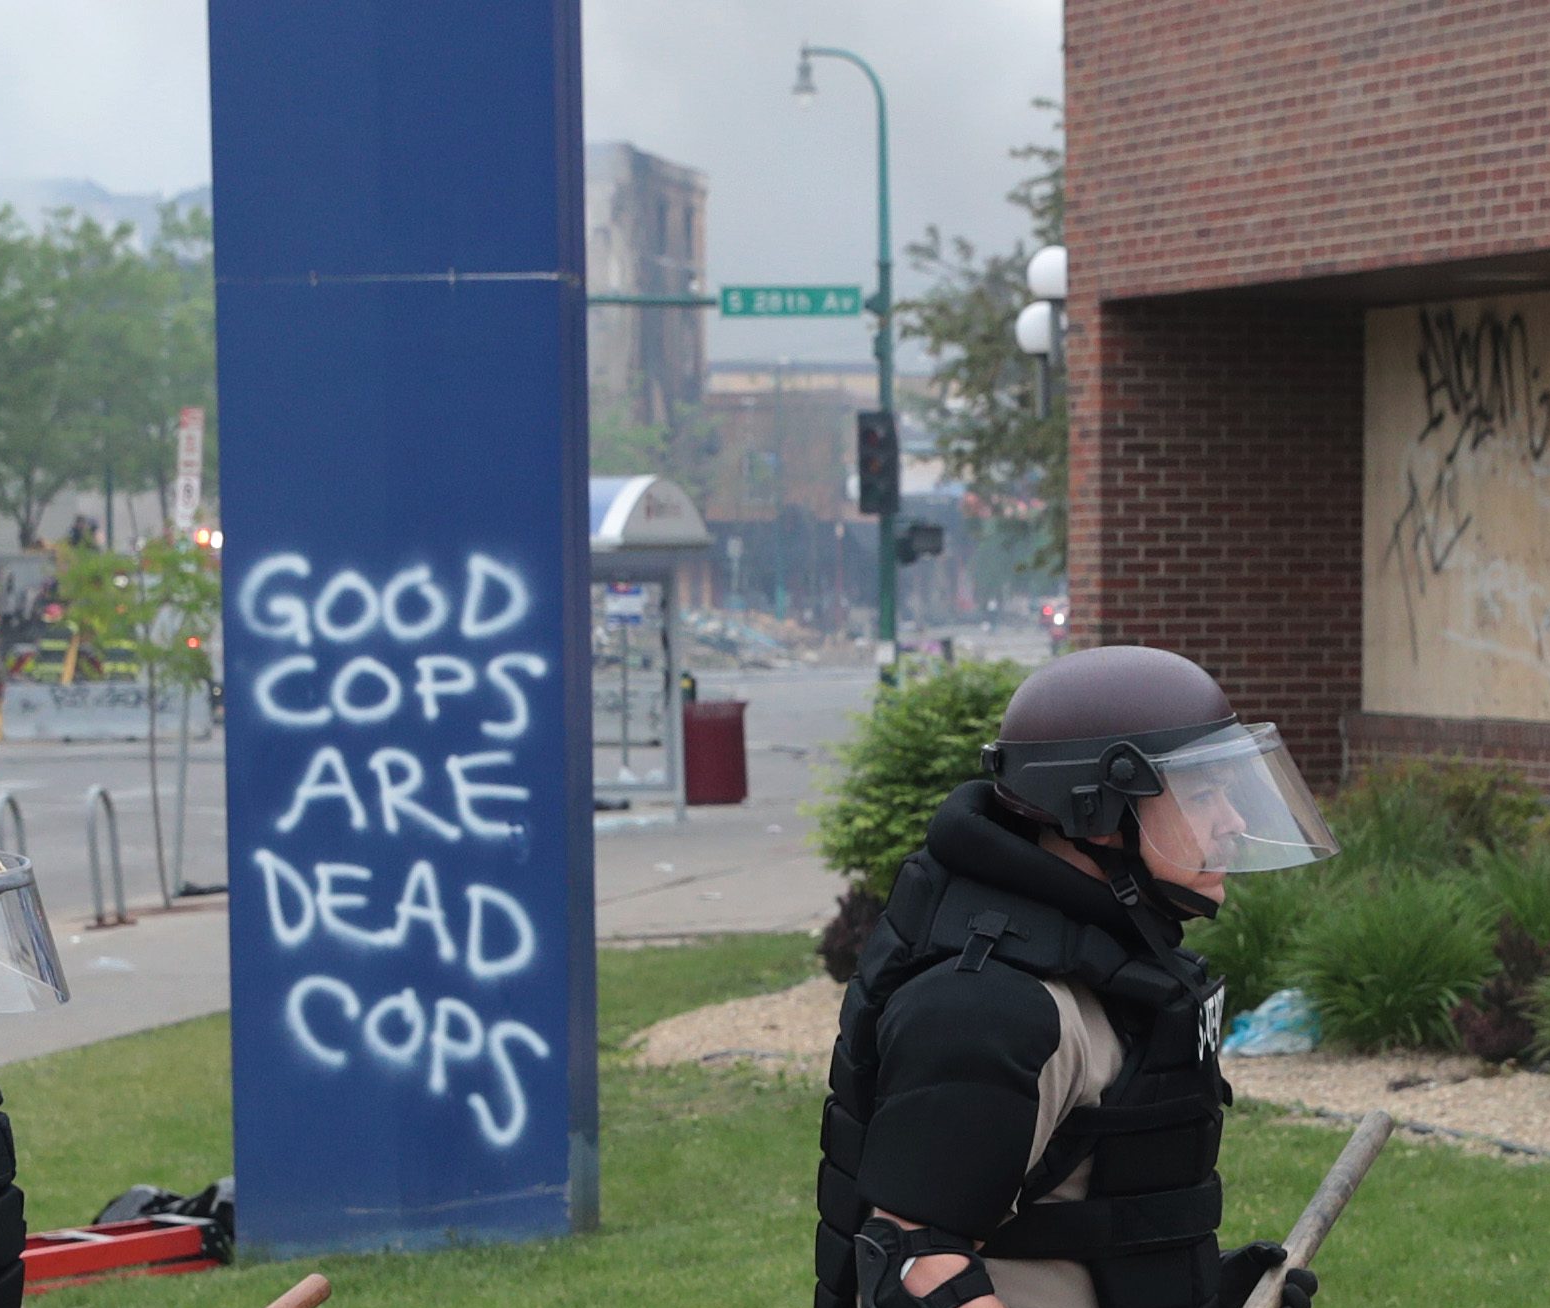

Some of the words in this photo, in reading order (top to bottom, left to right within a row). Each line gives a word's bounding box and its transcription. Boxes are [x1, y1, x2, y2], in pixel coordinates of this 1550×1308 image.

[727, 290, 744, 313] S
[753, 290, 813, 313] 28th
[822, 290, 854, 313] Av
[239, 552, 530, 647] GOOD
[254, 653, 547, 739] COPS
[275, 746, 530, 841] ARE
[254, 848, 536, 979] DEAD
[286, 974, 550, 1147] COPS
